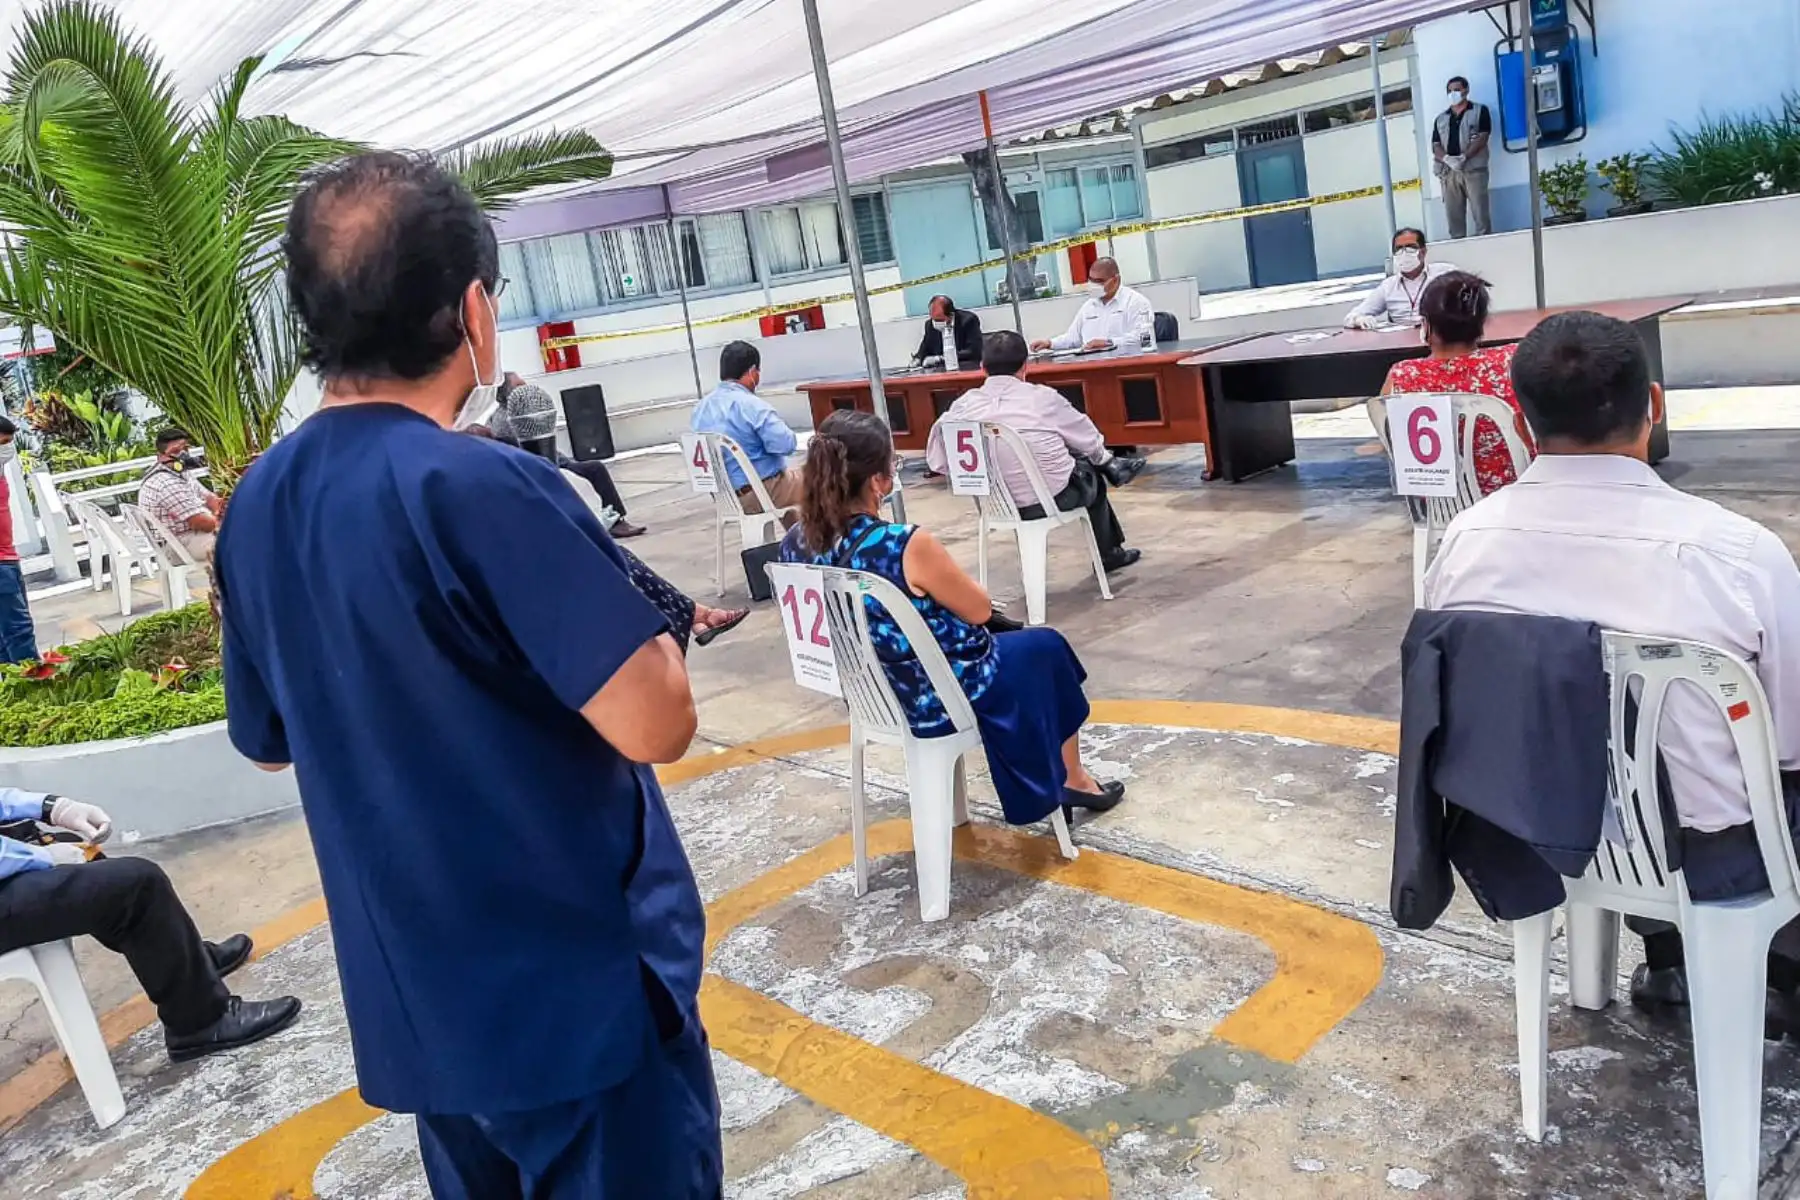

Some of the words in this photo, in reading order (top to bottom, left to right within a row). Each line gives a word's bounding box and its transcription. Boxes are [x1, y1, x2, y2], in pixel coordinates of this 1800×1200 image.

[693, 440, 708, 473] 4
[957, 430, 978, 472] 5
[1408, 406, 1442, 465] 6
[782, 585, 831, 648] 12
